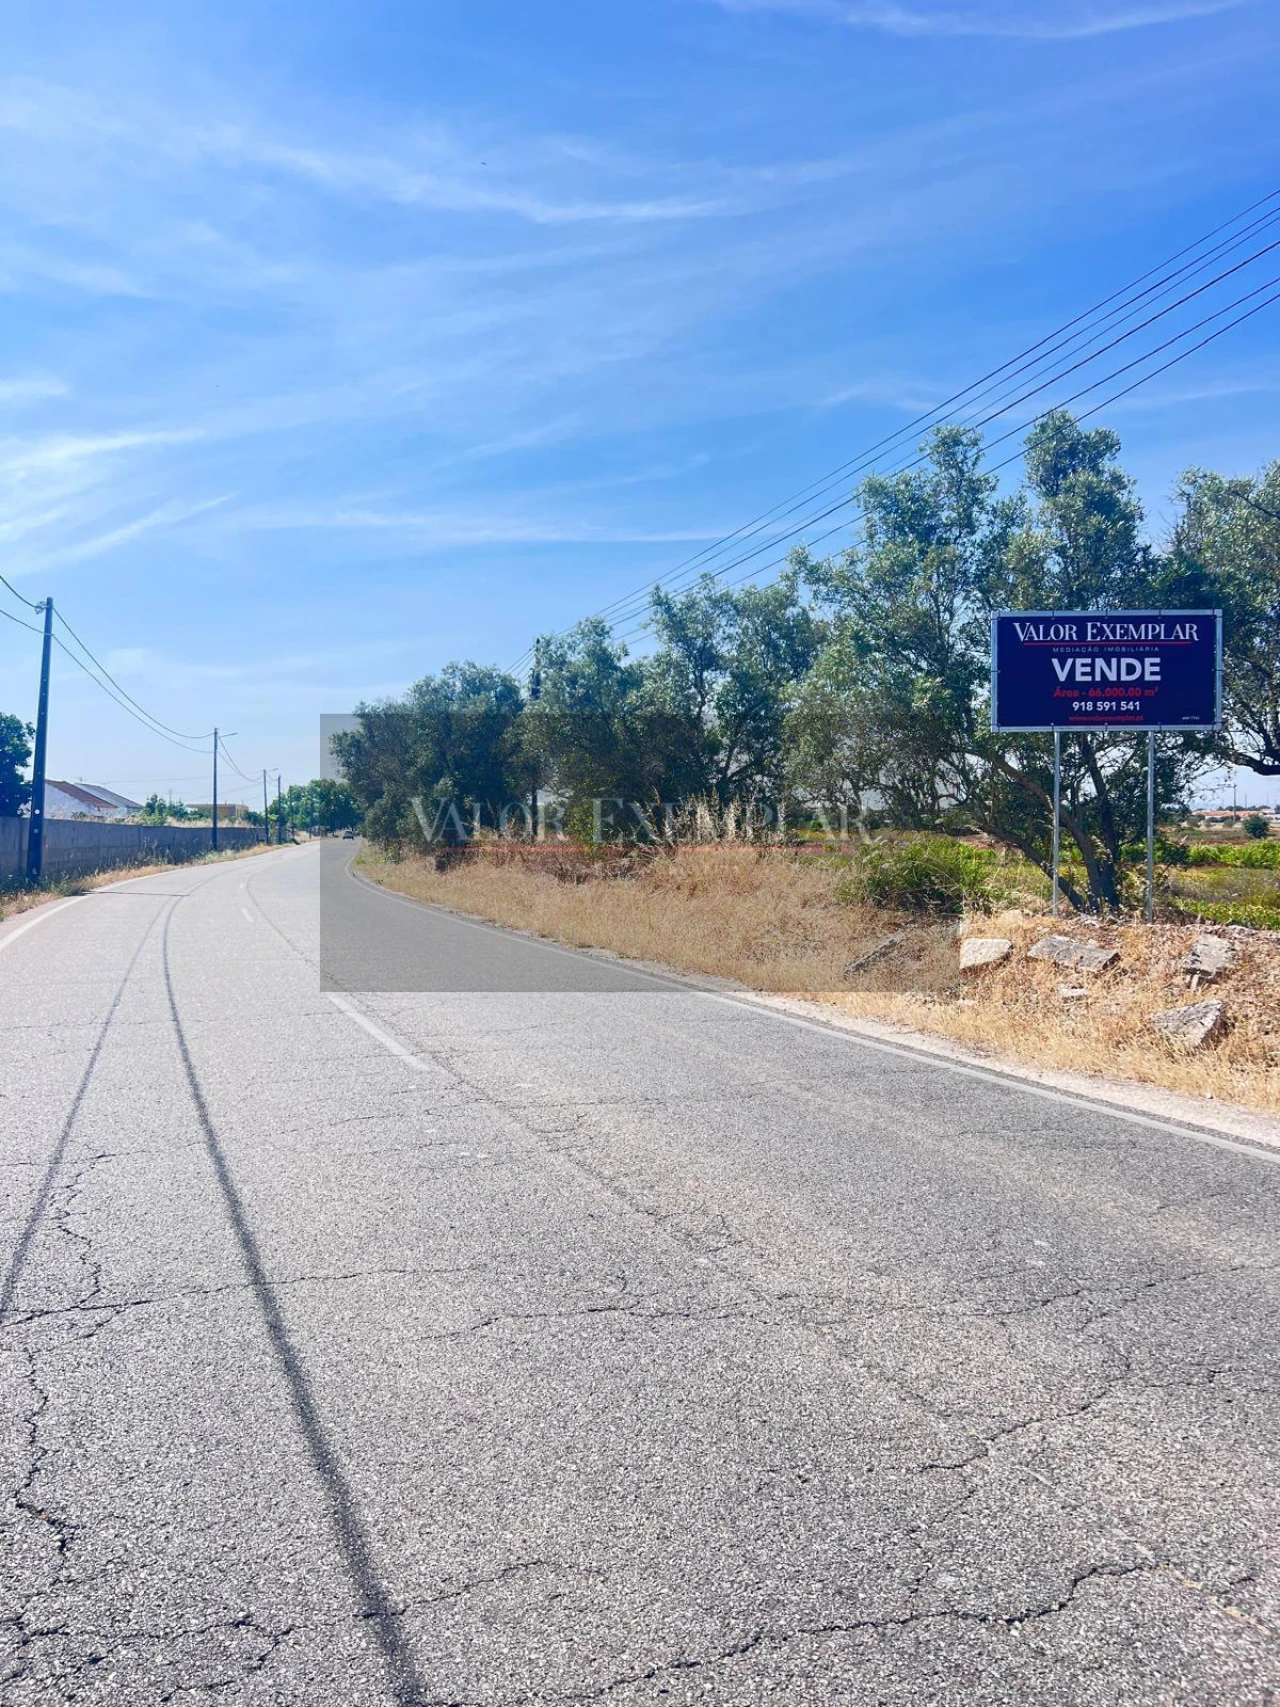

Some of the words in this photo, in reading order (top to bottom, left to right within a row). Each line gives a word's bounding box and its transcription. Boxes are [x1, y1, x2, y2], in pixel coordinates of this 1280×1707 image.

[1013, 622, 1078, 641] VALOR
[1087, 622, 1199, 641] EXEMPLAR
[1052, 658, 1161, 681] VENDE
[1054, 686, 1079, 697] Área
[1072, 702, 1093, 711] 918
[1096, 702, 1117, 711] 591
[1120, 702, 1140, 711] 541
